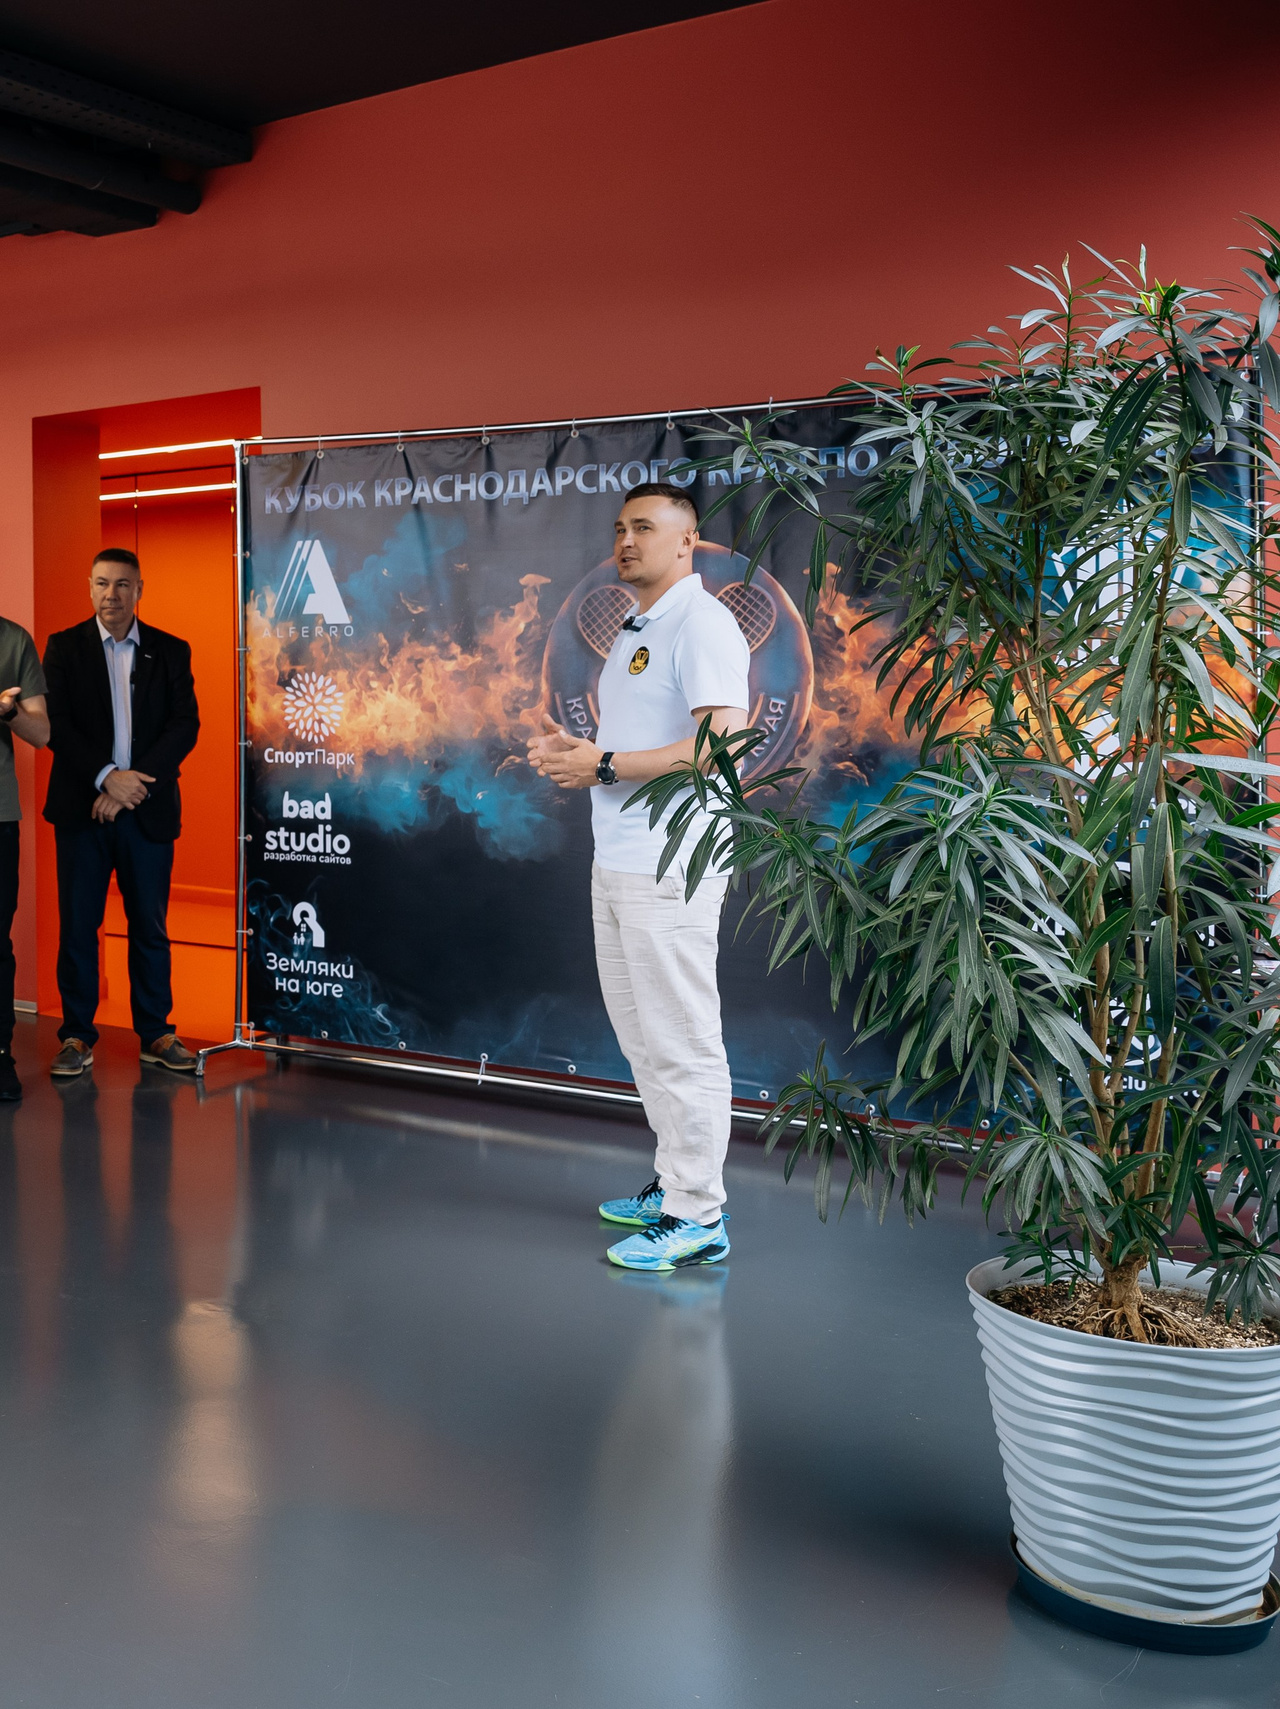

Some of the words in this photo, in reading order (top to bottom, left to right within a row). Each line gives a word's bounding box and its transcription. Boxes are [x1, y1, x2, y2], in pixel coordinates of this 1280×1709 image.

[265, 480, 367, 515] КУБОК
[374, 457, 698, 508] КРАСНОДАРСКОГО
[818, 444, 880, 479] ПО
[262, 625, 354, 638] ALFERRO
[263, 747, 355, 769] СпортПарк
[282, 790, 332, 820] bad
[264, 823, 351, 855] studio
[263, 850, 317, 863] разработка
[318, 853, 352, 865] сайтов
[266, 952, 354, 979] Земляки
[275, 976, 300, 994] на
[306, 980, 344, 998] юге
